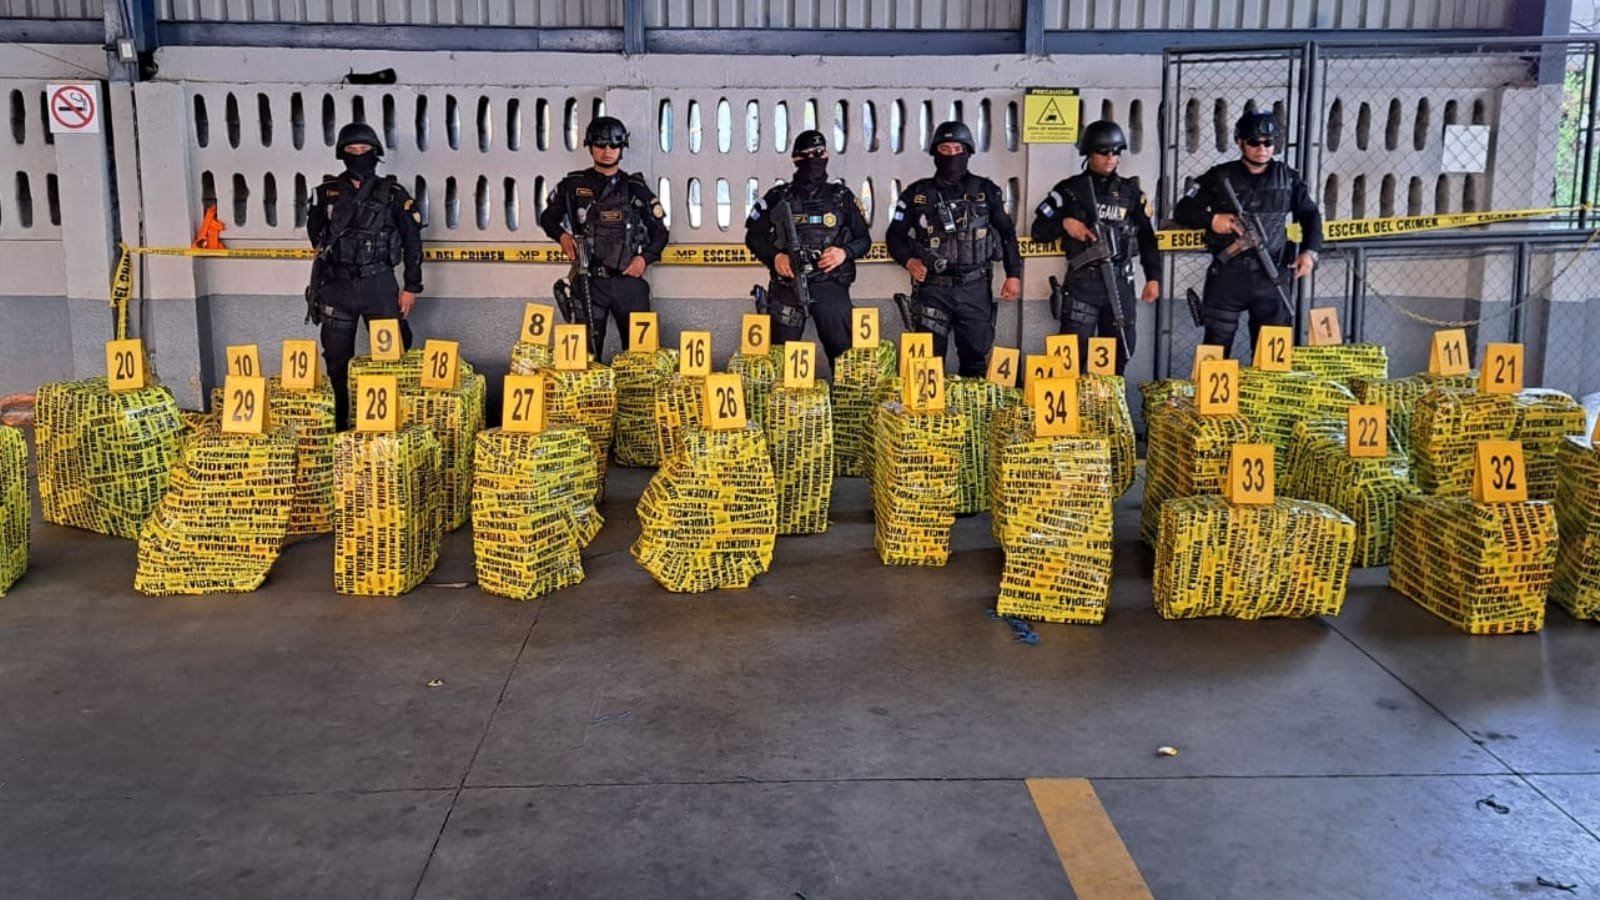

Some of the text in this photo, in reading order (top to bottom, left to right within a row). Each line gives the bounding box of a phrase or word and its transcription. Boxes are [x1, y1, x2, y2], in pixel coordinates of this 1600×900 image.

[1096, 204, 1120, 220] GAIA
[1328, 217, 1439, 238] ESCENA DEL CRIMEN
[1171, 232, 1206, 247] ESCEN
[436, 251, 454, 260] DEL
[461, 250, 504, 260] CRIMEN
[547, 251, 568, 262] ESC
[703, 249, 746, 262] ESCENA
[528, 313, 545, 336] 8
[635, 322, 650, 344] 7
[748, 324, 763, 346] 6
[860, 314, 871, 340] 5
[1320, 316, 1332, 338] 1
[377, 329, 393, 352] 9
[562, 334, 579, 361] 17
[1268, 337, 1285, 363] 12
[685, 339, 705, 368] 16
[790, 349, 809, 379] 15
[1094, 346, 1109, 367] 3
[1443, 340, 1462, 366] 11
[115, 351, 134, 380] 20
[234, 354, 252, 376] 10
[290, 351, 308, 379] 19
[430, 351, 449, 379] 18
[997, 357, 1011, 379] 4
[1495, 355, 1516, 384] 21
[917, 369, 937, 399] 25
[1209, 372, 1230, 404] 23
[232, 389, 255, 422] 29
[365, 387, 387, 420] 28
[512, 388, 534, 421] 27
[716, 386, 737, 419] 26
[1044, 390, 1067, 425] 34
[1358, 417, 1378, 447] 22
[1464, 423, 1504, 433] VIDENCIA
[1525, 419, 1564, 428] VIDENCIA
[189, 461, 249, 470] EVIDENCIA
[1009, 469, 1061, 480] EVIDENCIA
[1242, 458, 1265, 492] 33
[1491, 455, 1517, 490] 32
[201, 489, 255, 498] EVIDENCIA
[355, 471, 364, 518] EVIDENCIA
[377, 461, 386, 510] EVIDENCIA
[226, 507, 278, 515] EVIDENCIA
[344, 490, 354, 538] EVIDENCIA
[1051, 499, 1104, 508] EVIDENCIA
[185, 534, 237, 542] EVIDENCIA
[198, 544, 250, 552] EVIDENCIA
[716, 540, 760, 549] EVIDENCIA
[356, 536, 365, 582] EVIDENCIA
[377, 528, 386, 574] EVIDENCIA
[1007, 545, 1046, 555] IDENCIA
[1007, 566, 1036, 578] ENCIA
[1187, 541, 1202, 590] EVIDENCIA
[1332, 542, 1349, 590] EVIDENCIA
[1514, 563, 1554, 572] EVIDENC
[184, 579, 234, 588] EVIDENCIA
[1002, 588, 1041, 601] IDENCIA
